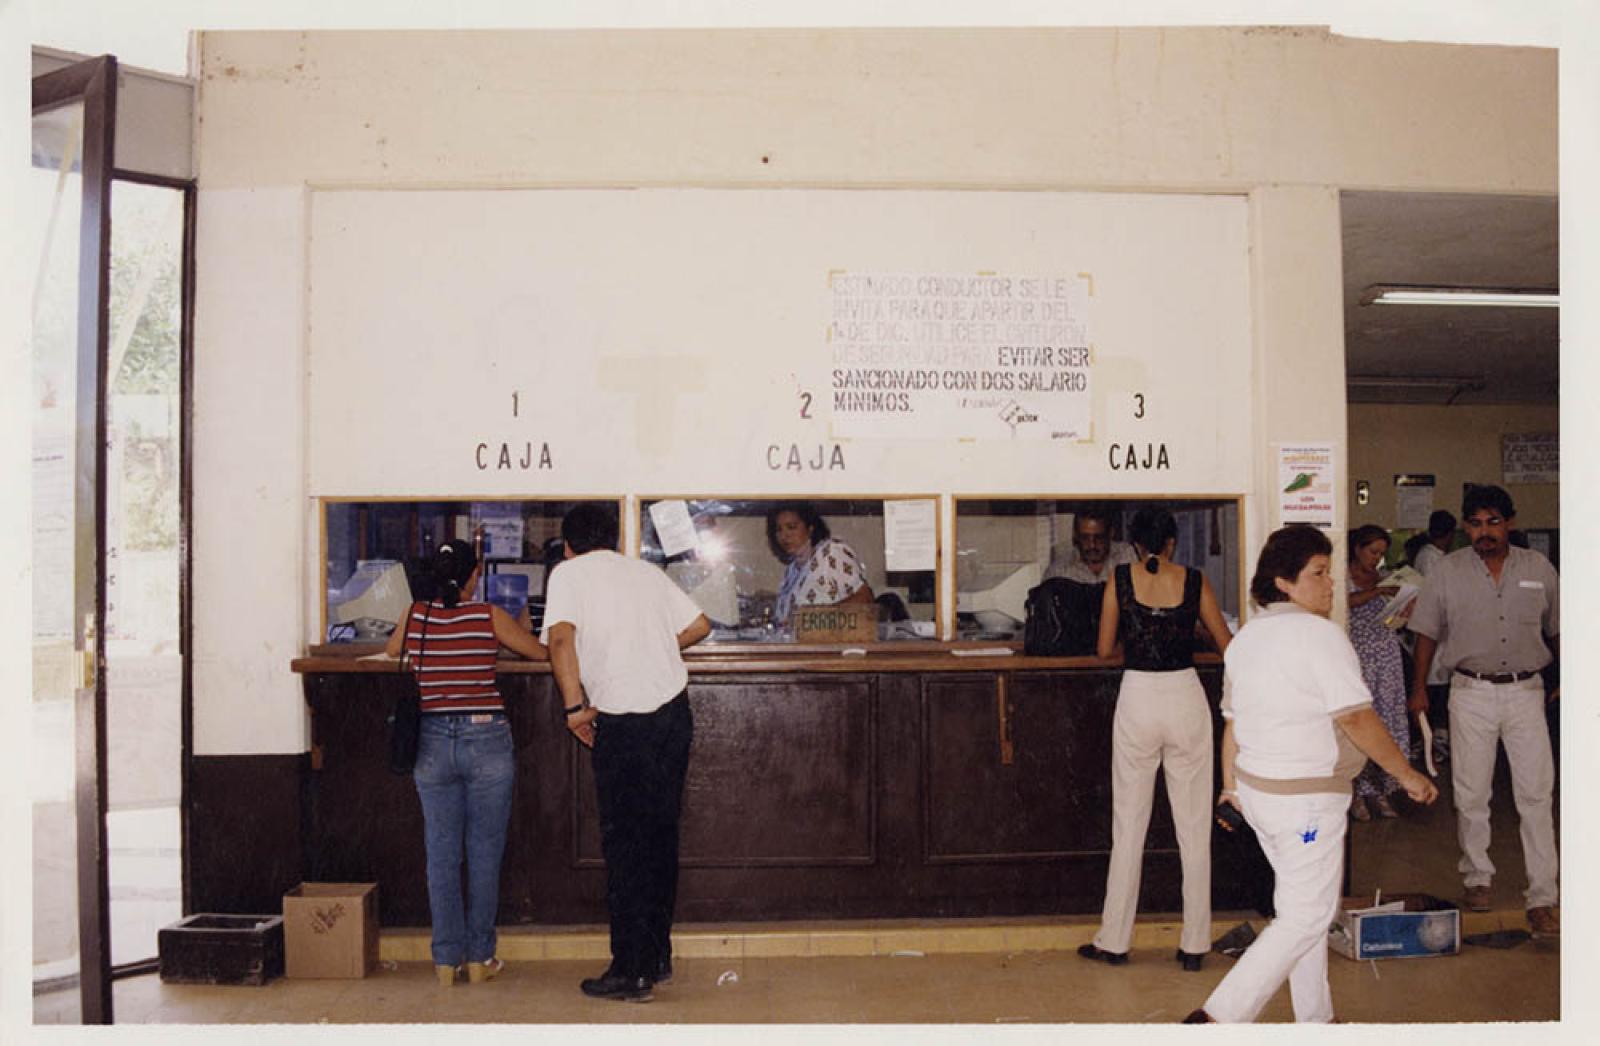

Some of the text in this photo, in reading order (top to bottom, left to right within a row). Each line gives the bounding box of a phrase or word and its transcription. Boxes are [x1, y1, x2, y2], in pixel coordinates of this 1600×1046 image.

[916, 276, 1011, 298] CONDUCTOR
[997, 346, 1053, 367] EVITAR
[1057, 347, 1089, 368] SER
[832, 369, 1087, 392] SANCIONADO CON DOS SALARIO
[511, 391, 520, 418] 1
[800, 392, 813, 419] 2
[833, 392, 914, 412] MINIMOS.
[1134, 392, 1145, 419] 3
[475, 442, 553, 470] CAJA
[766, 443, 846, 471] CAJA
[1109, 443, 1170, 470] CAJA
